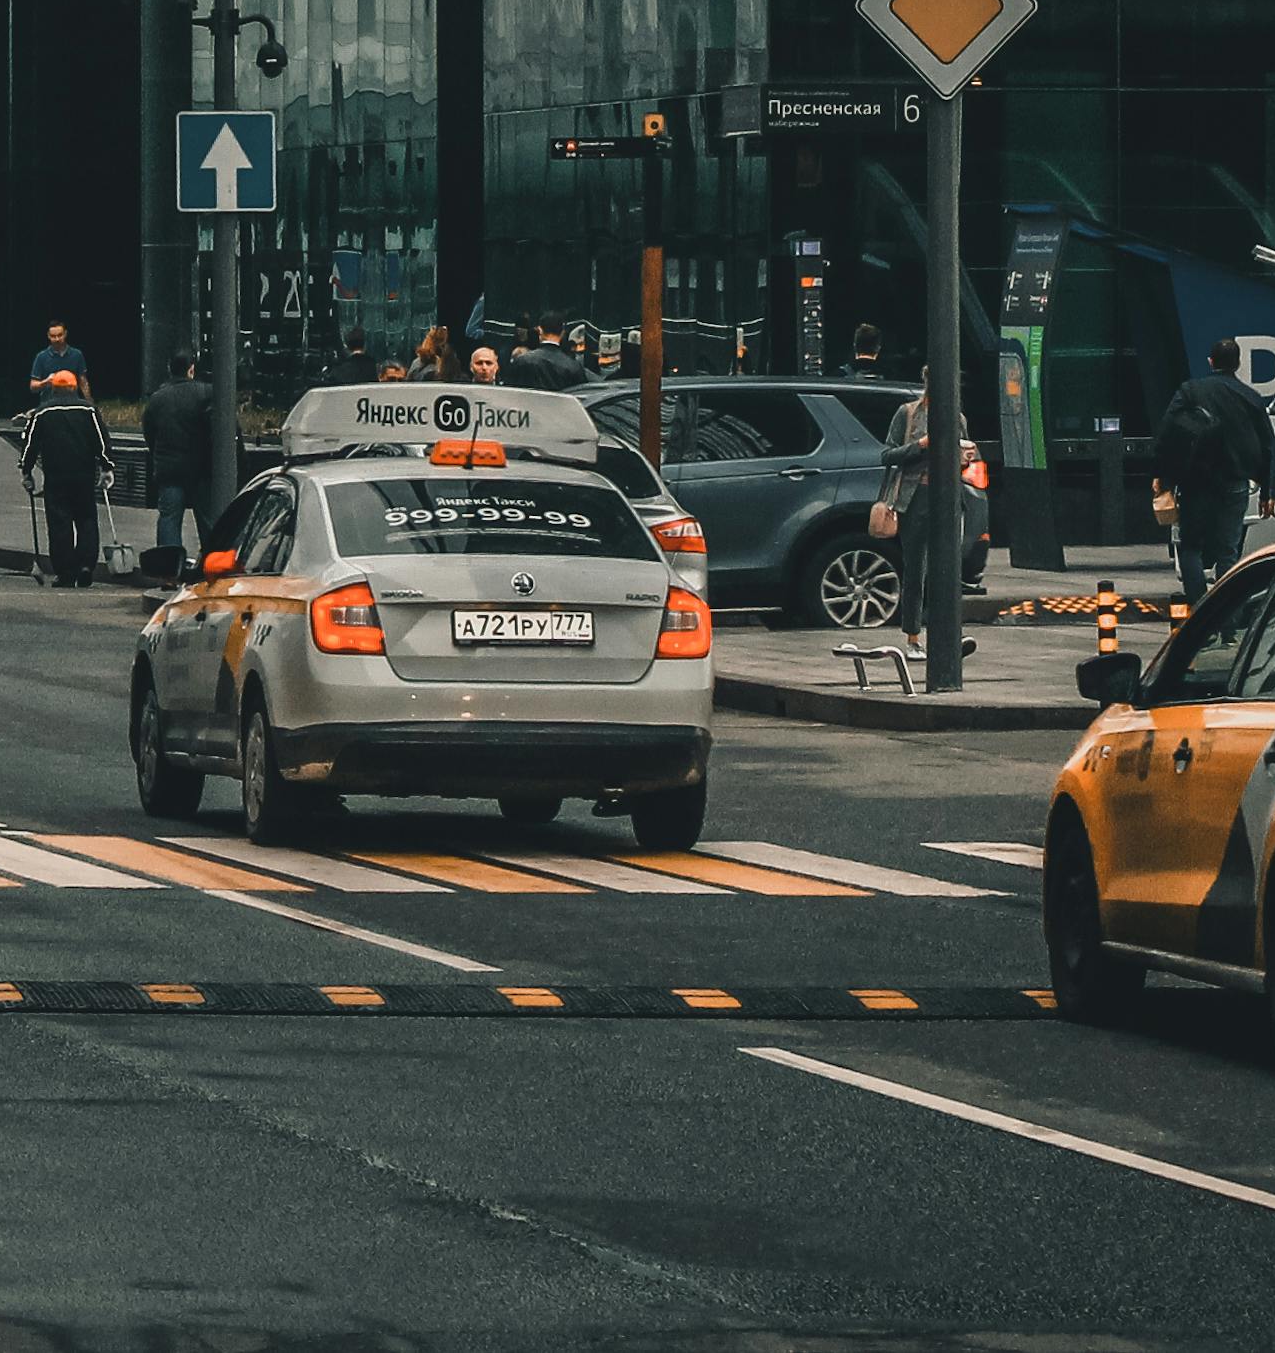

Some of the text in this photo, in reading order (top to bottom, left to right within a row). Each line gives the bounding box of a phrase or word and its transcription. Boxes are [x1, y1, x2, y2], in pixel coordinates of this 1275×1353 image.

[768, 94, 920, 123] Пресненская 6
[356, 397, 530, 428] Яндекс Go Такси
[435, 496, 536, 507] Яндекс Такси
[384, 507, 592, 528] 999-99-99
[462, 613, 587, 637] А721РУ 777
